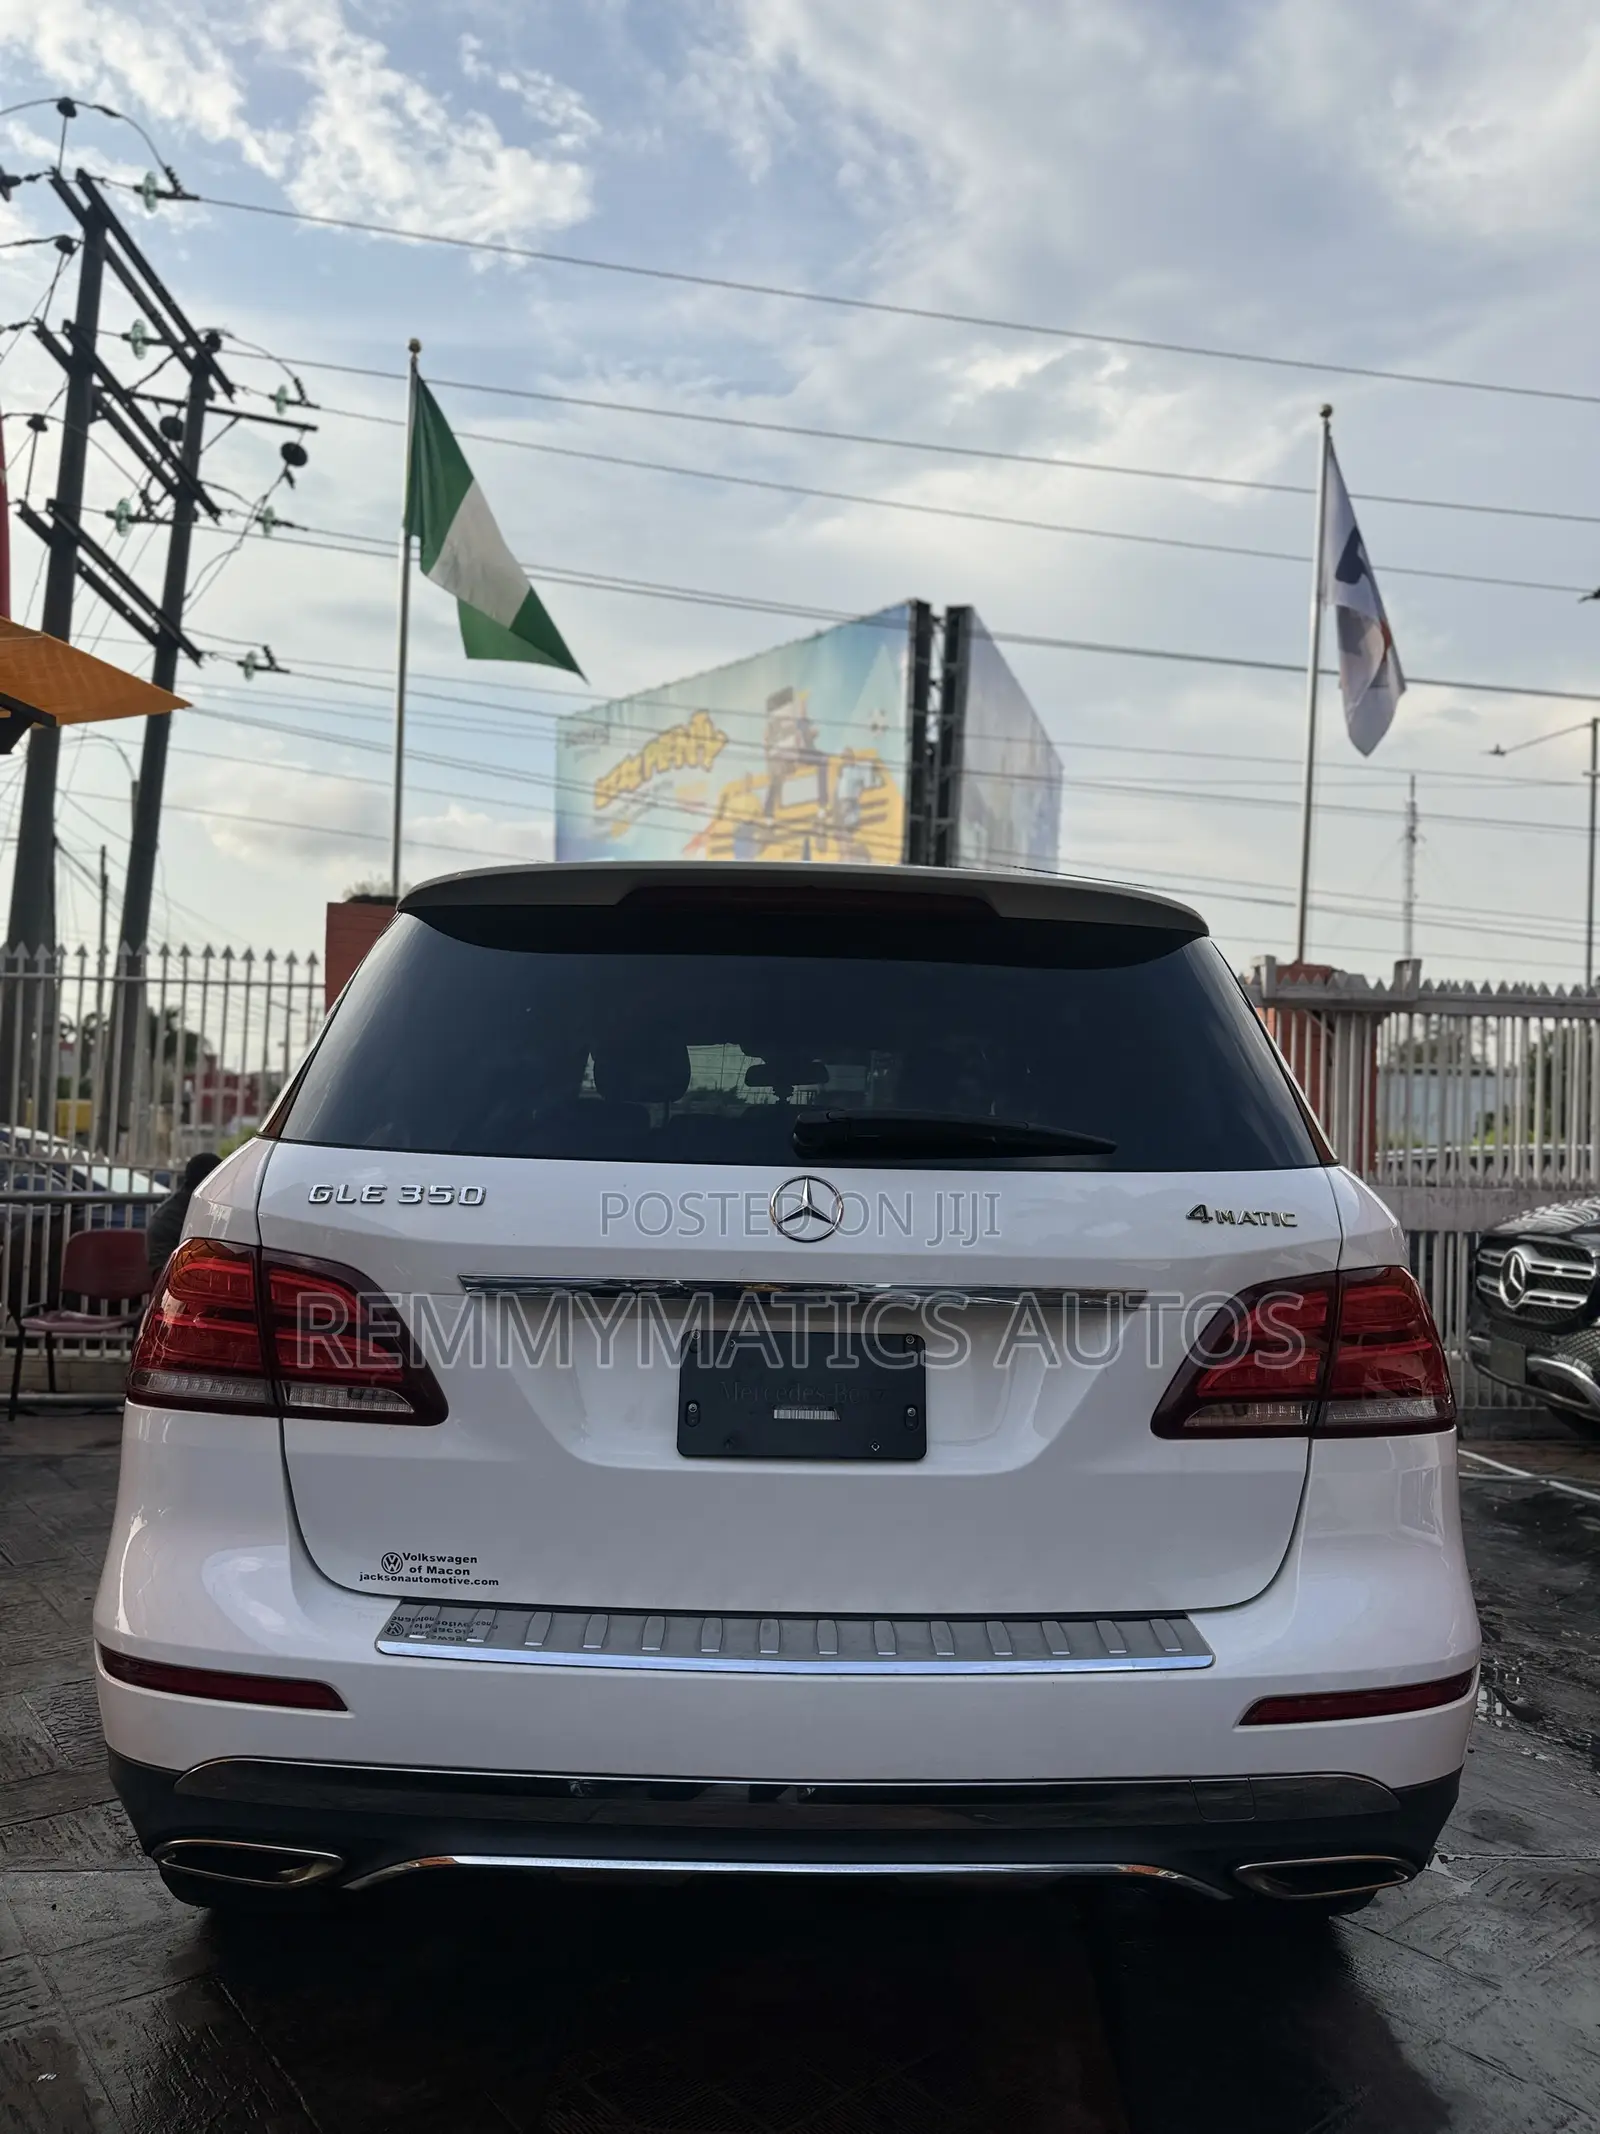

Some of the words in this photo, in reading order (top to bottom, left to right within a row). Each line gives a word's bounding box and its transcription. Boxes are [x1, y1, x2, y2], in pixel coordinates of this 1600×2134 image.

[308, 1183, 388, 1204] GLE
[398, 1184, 487, 1206] 350
[1185, 1203, 1298, 1228] 4MATIC
[403, 1552, 478, 1565] Volkswagen
[409, 1565, 423, 1574] of
[426, 1565, 471, 1576] Macon
[359, 1572, 499, 1586] jacksonautomotive.com
